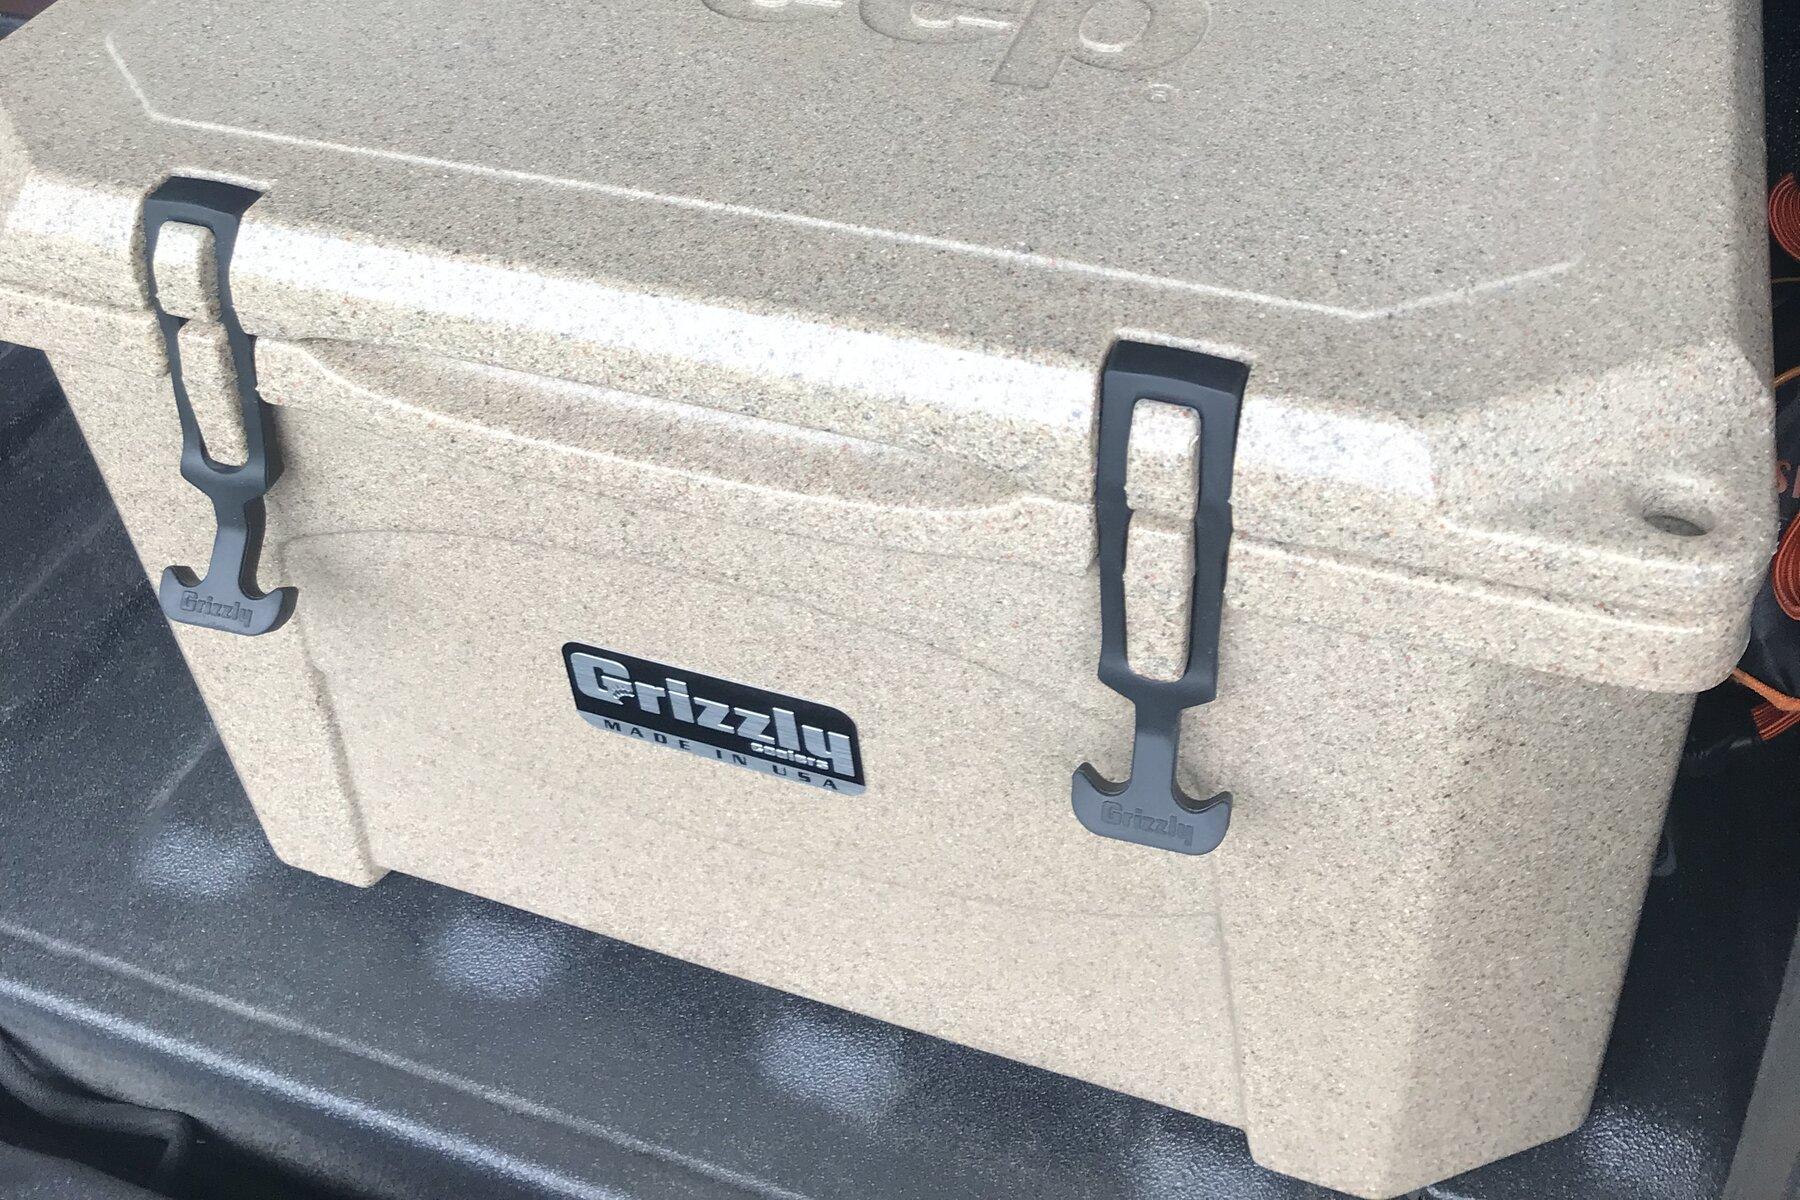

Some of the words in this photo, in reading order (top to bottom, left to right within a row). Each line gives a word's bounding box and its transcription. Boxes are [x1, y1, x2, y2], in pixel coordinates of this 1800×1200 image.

[180, 590, 254, 628] Grizzly
[570, 652, 855, 777] Grizzly
[604, 718, 693, 751] MADE
[715, 749, 748, 766] IN
[772, 764, 838, 791] USA
[1101, 800, 1195, 848] Grizzly
